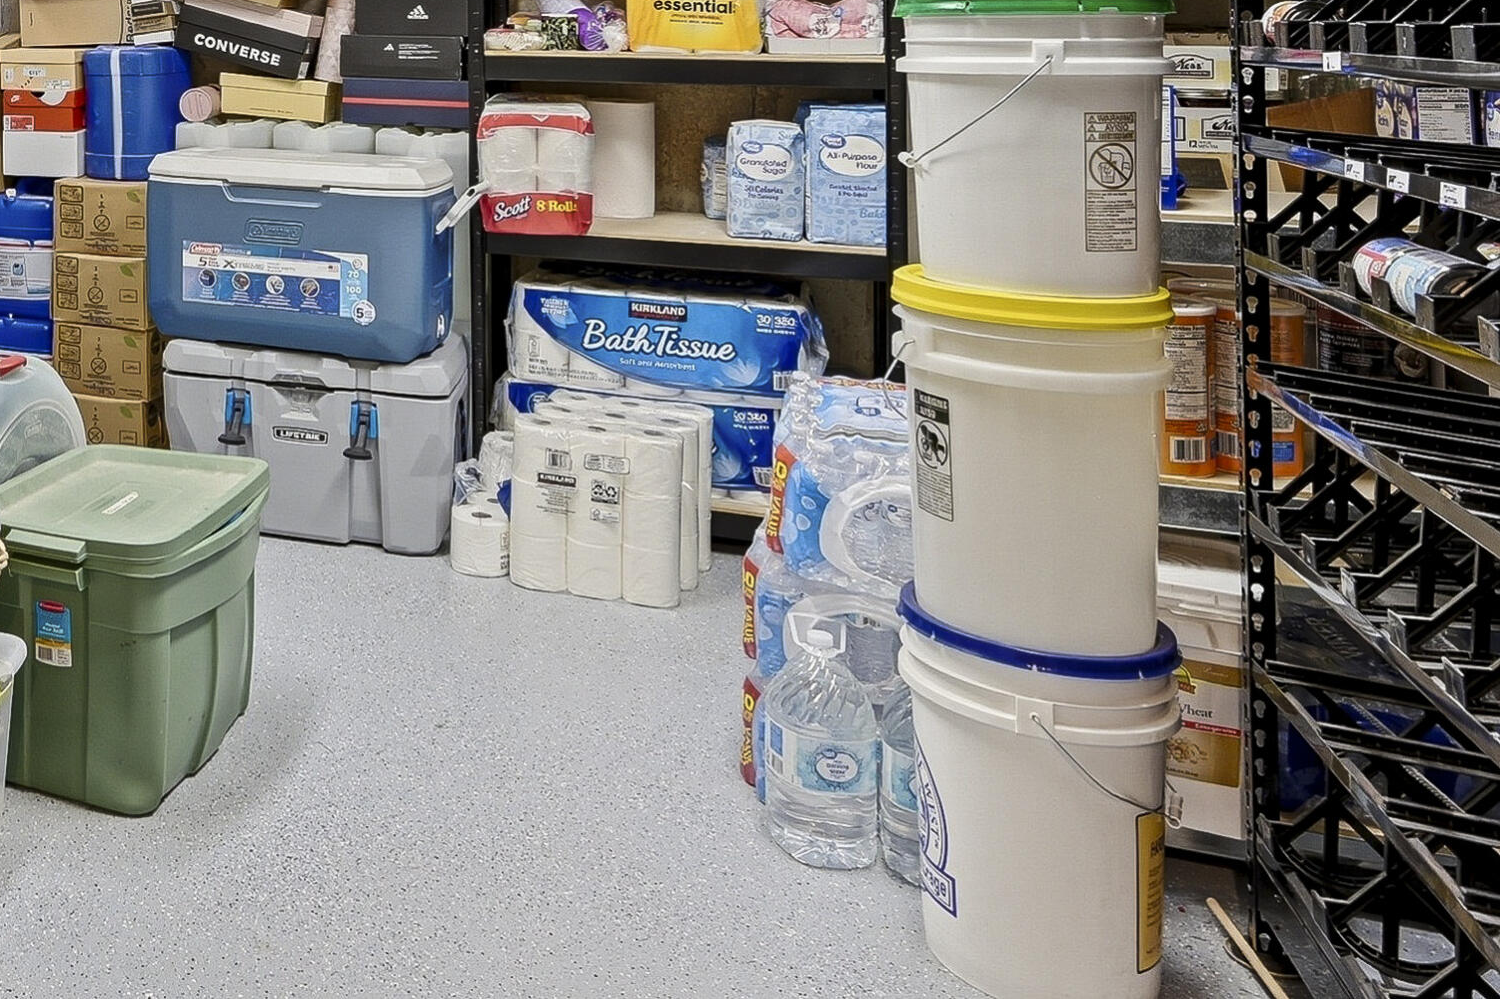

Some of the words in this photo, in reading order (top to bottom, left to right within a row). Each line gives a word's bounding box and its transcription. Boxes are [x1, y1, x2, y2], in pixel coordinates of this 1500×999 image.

[193, 33, 281, 67] CONVERSE
[739, 155, 788, 169] Granulated
[826, 150, 878, 162] All-Purpose
[762, 165, 788, 177] Sugar
[493, 196, 531, 222] Scott
[536, 199, 545, 212] 8
[198, 255, 207, 267] 5
[345, 285, 362, 295] 100
[356, 307, 365, 319] 5
[631, 301, 686, 317] KIRKLAND
[756, 313, 772, 326] 30
[582, 318, 653, 355] Bath
[651, 325, 737, 363] Tissue
[766, 495, 784, 537] VALUE
